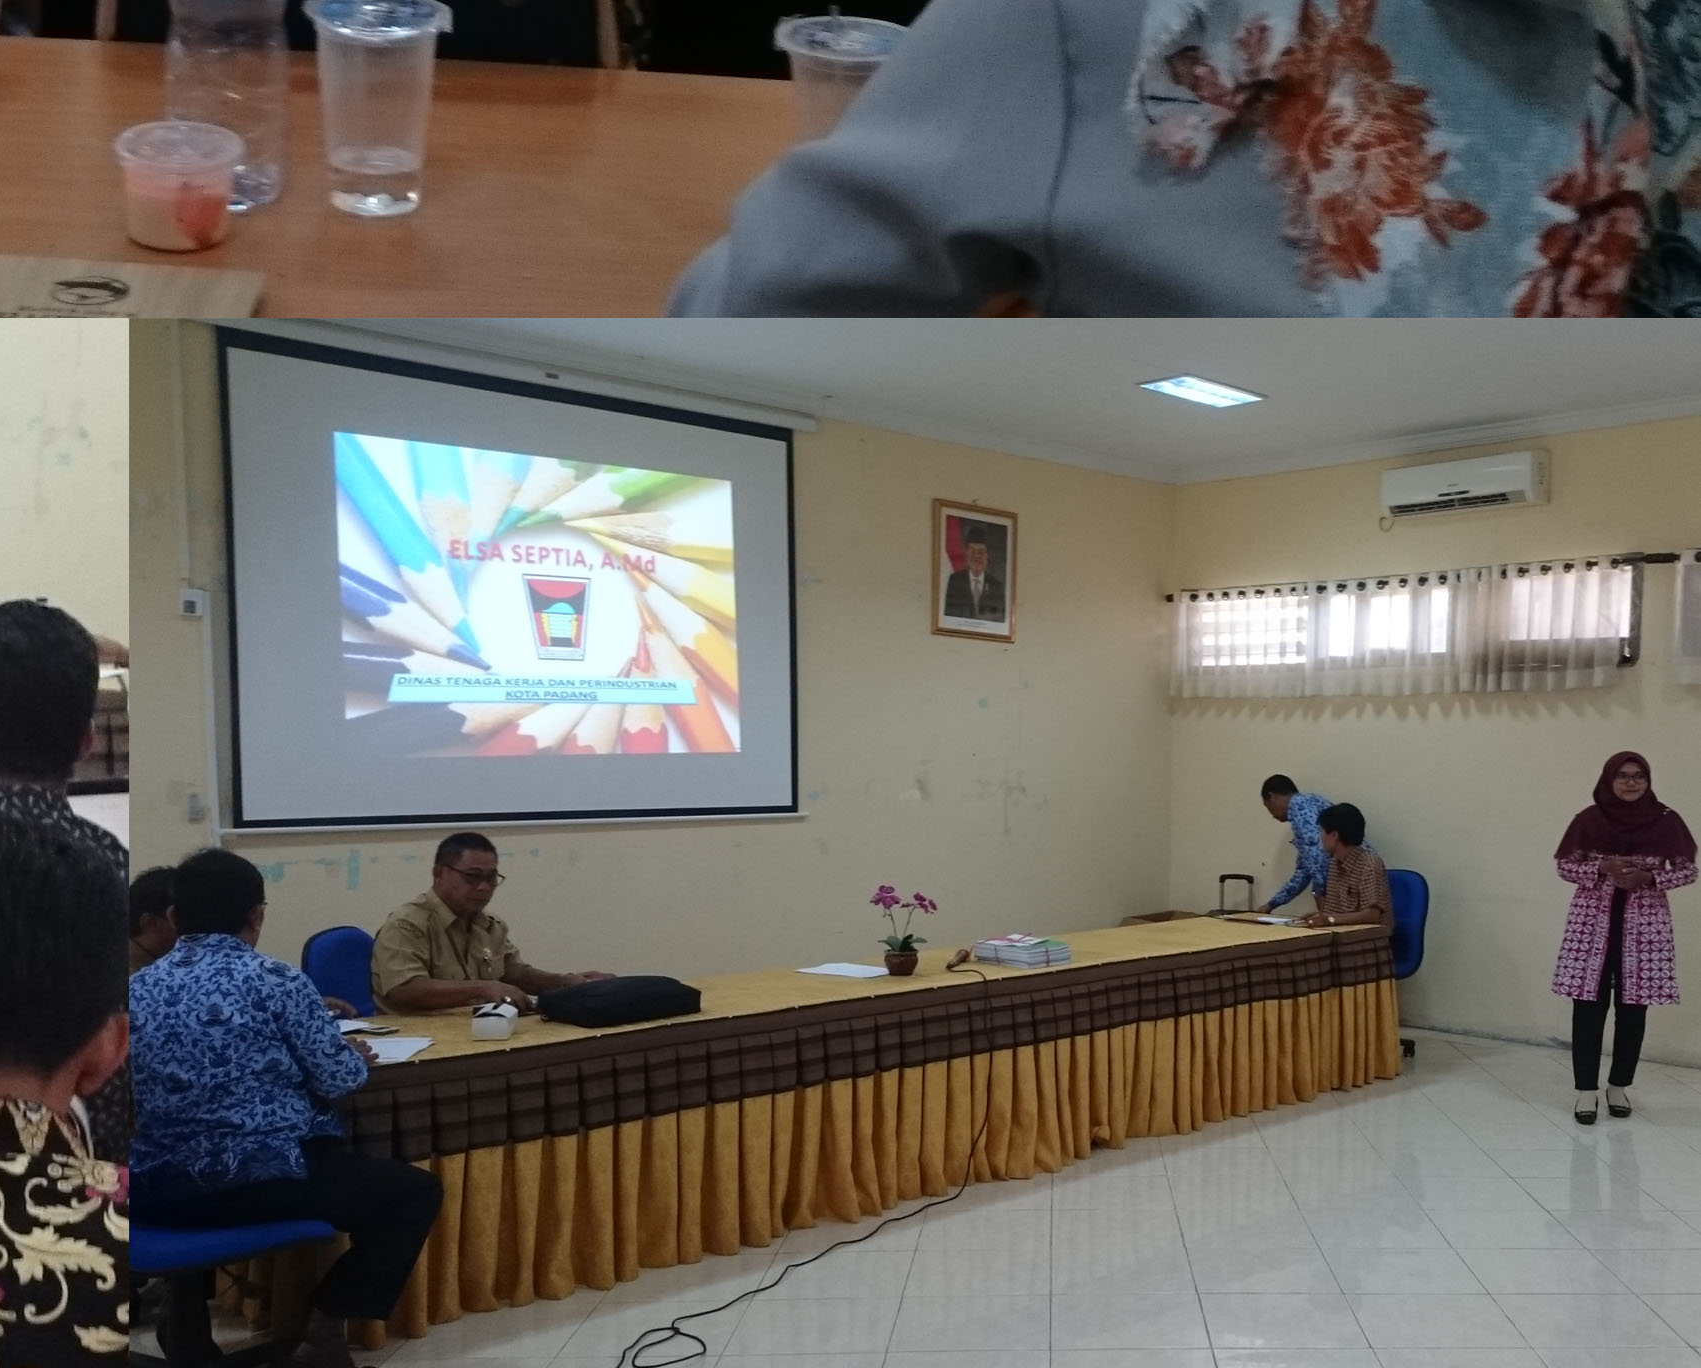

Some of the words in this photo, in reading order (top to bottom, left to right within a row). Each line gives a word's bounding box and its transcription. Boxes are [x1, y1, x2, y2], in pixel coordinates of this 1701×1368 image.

[449, 539, 504, 562] ELSA
[511, 544, 593, 571] SEPTIA,
[600, 551, 656, 573] A.Md
[396, 676, 442, 686] DINAS
[446, 676, 501, 686] TENAGA
[505, 678, 545, 687] KERJA
[548, 678, 576, 688] DAN
[579, 679, 677, 690] PERINDUSTRIAN
[505, 690, 540, 699] KOTA
[543, 690, 598, 700] PADANG
